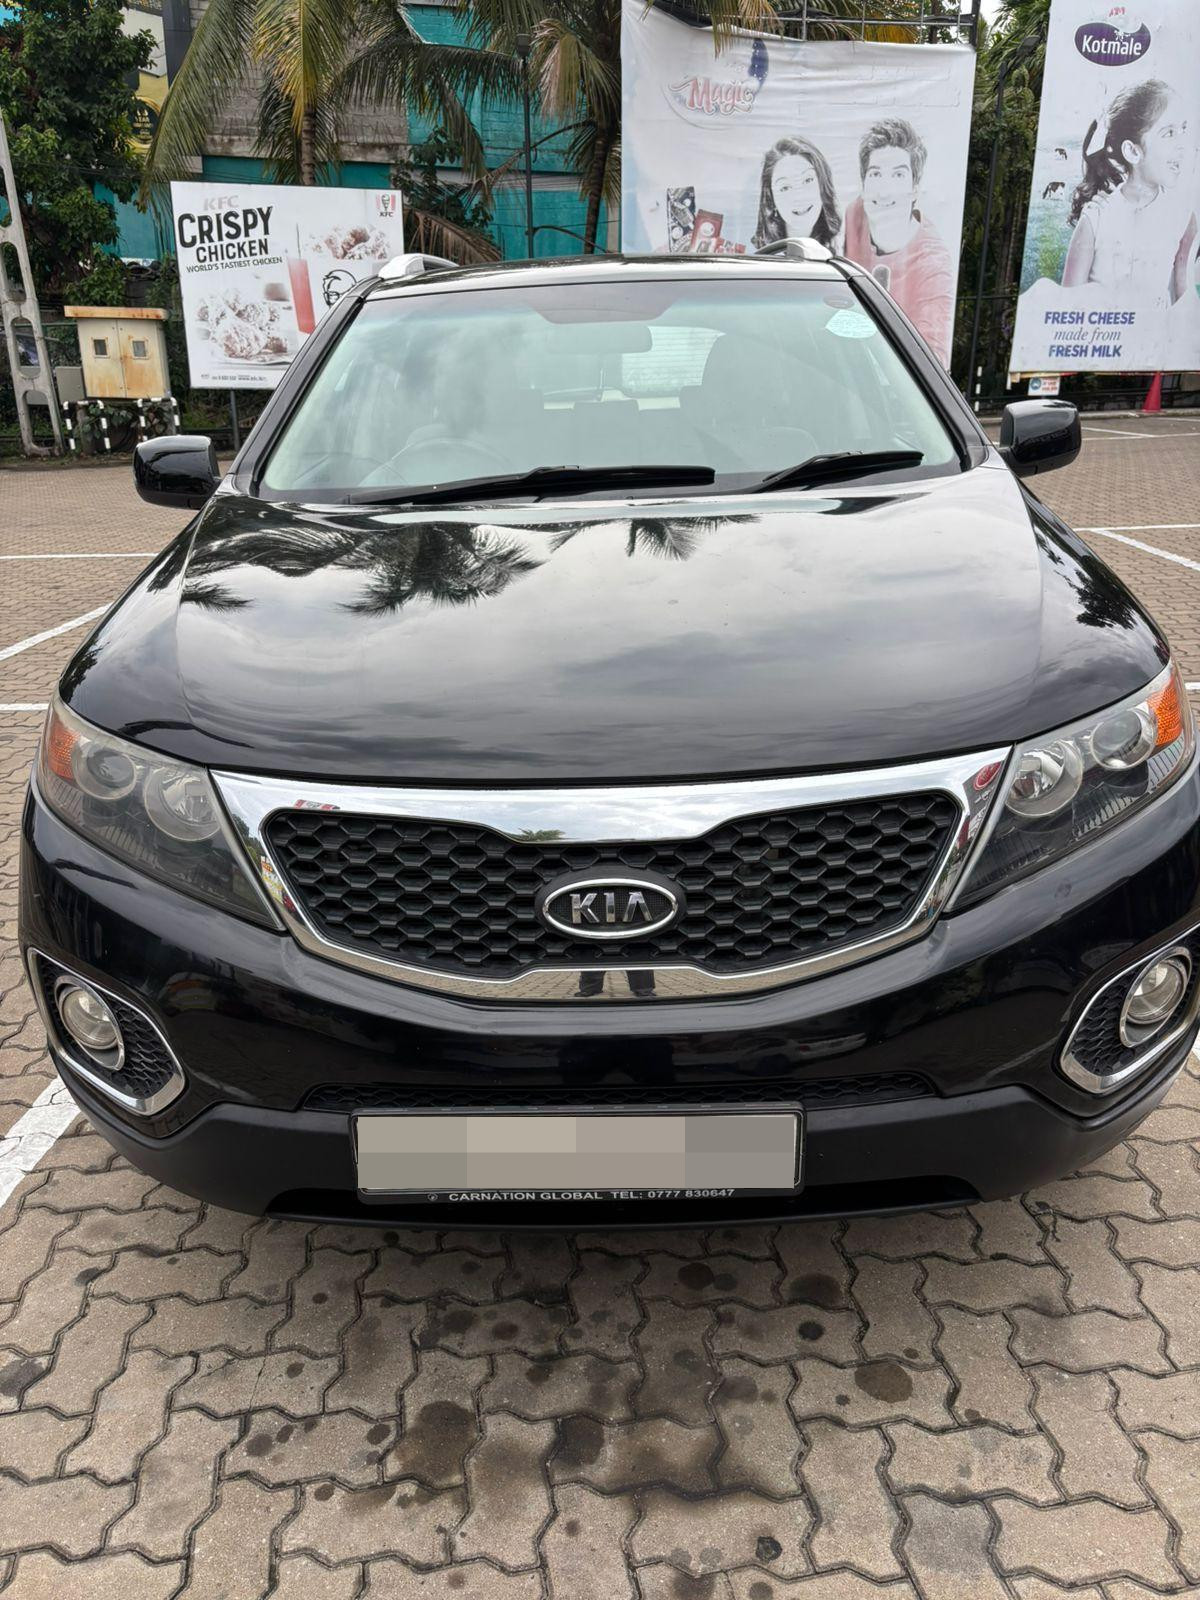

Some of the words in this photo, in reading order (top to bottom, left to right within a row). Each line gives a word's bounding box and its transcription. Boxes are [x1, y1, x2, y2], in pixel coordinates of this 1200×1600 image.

[1081, 34, 1142, 56] Kotmale
[668, 77, 755, 115] Magic
[203, 195, 240, 211] KFC
[178, 206, 274, 248] CRISPY
[196, 238, 269, 264] CHICKEN
[186, 262, 220, 273] WORLD'S
[221, 260, 251, 270] TASTIEST
[252, 257, 283, 266] CHICKEN
[1044, 311, 1085, 325] FRESH
[1087, 311, 1136, 325] CHEESE
[1054, 327, 1089, 341] made
[1088, 327, 1122, 344] from
[1048, 345, 1089, 358] FRESH
[1090, 345, 1122, 358] MILK
[569, 891, 654, 924] KIA
[449, 1192, 536, 1201] CARNATION
[540, 1191, 603, 1200] GLOBAL
[610, 1191, 643, 1200] TEL:
[647, 1189, 680, 1199] 0777
[684, 1188, 736, 1198] 830647
